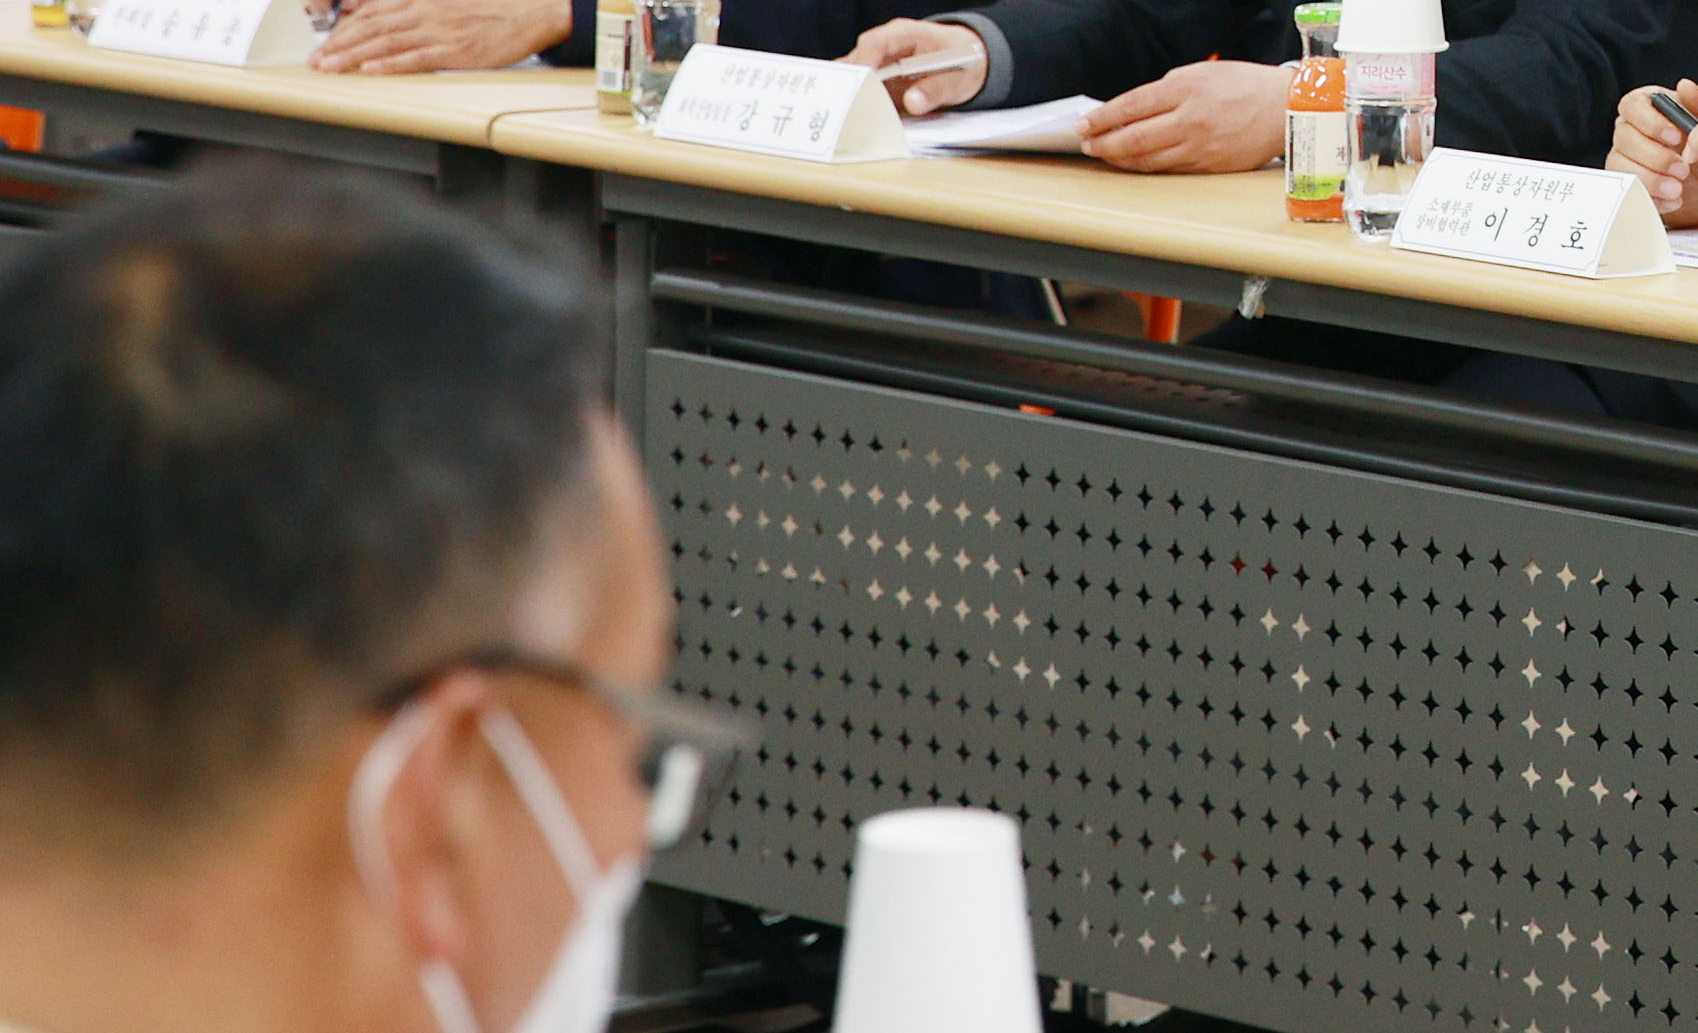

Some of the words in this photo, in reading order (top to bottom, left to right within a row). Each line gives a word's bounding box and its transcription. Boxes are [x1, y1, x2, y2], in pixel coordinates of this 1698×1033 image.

[1361, 66, 1406, 80] 지리산수
[738, 100, 830, 142] 강규형
[1464, 168, 1576, 203] 산업통상자원부
[1484, 208, 1588, 251] 이경호
